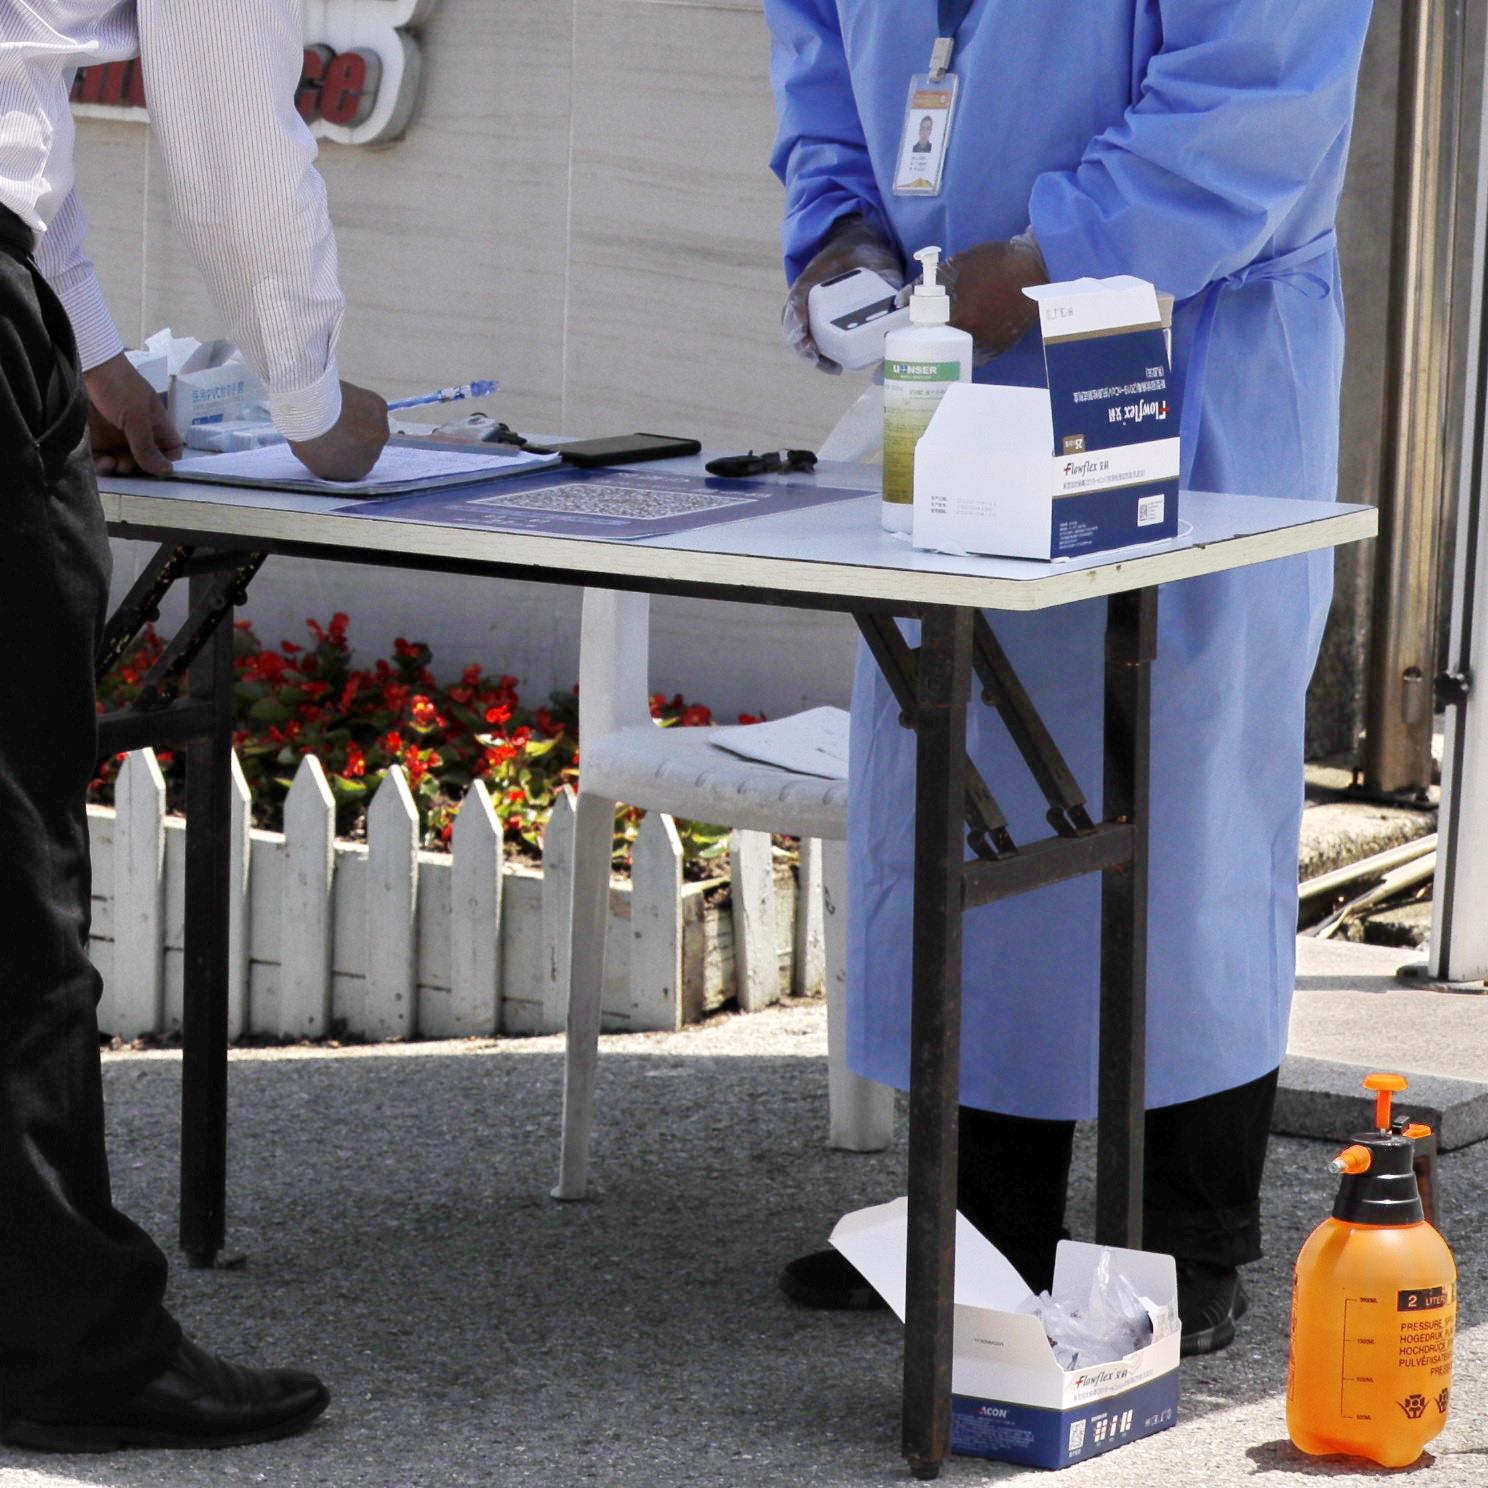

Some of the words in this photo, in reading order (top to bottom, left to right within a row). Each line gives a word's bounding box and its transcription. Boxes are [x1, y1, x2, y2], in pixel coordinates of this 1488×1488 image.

[1124, 399, 1170, 424] Flowflex
[1064, 460, 1097, 477] Flowflex
[1407, 1295, 1417, 1308] 2
[1400, 1319, 1442, 1332] PRESSURE
